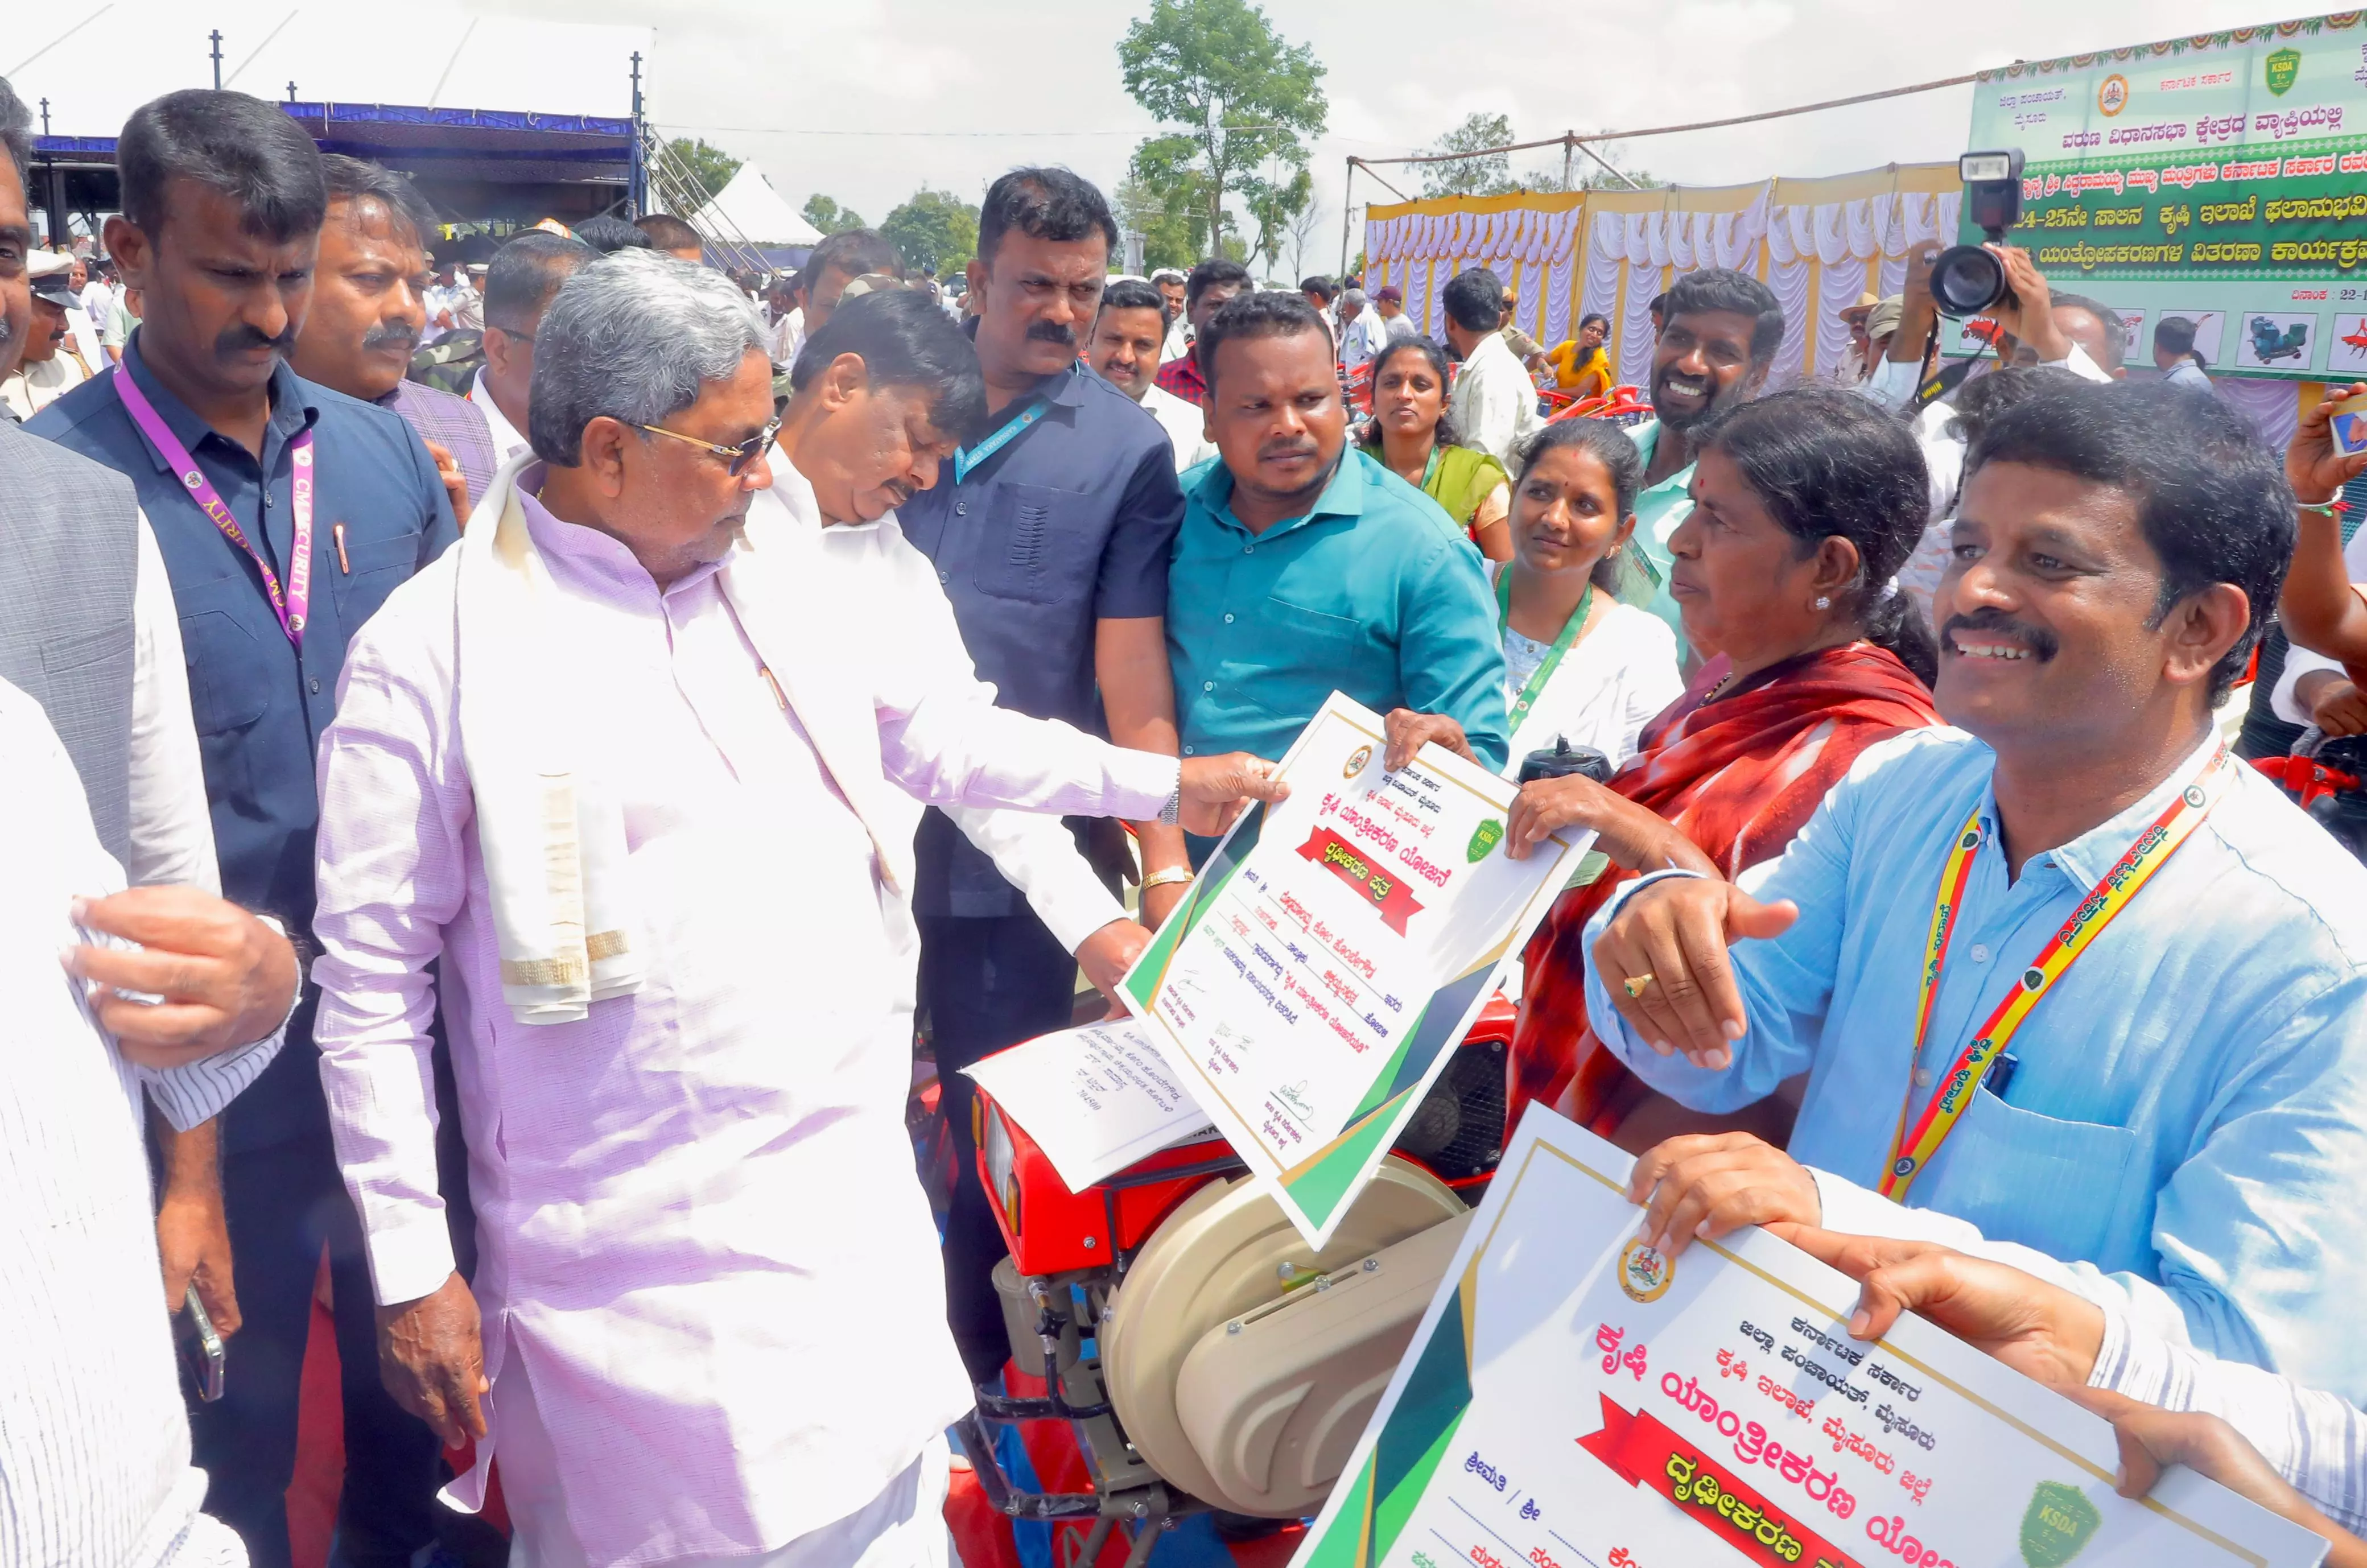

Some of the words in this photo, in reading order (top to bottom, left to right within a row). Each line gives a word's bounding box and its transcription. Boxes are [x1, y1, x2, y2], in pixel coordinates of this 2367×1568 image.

[2160, 75, 2197, 90] ಕರ್ನಾಟಕ
[2201, 71, 2232, 85] ಸರ್ಕಾರ
[2271, 62, 2292, 72] KSDA
[1999, 96, 2017, 109] ಜಿಲ್ಲಾ
[2014, 112, 2047, 130] ಮೈಸೂರು
[2062, 130, 2101, 148] ವರುಣ
[2109, 122, 2187, 146] ವಿಧಾನಸಭಾ
[2196, 112, 2246, 145] ಕ್ಷೇತ್ರದ
[2255, 105, 2343, 139] ವ್ಯಾಪ್ತಿಯಲ್ಲಿ
[2045, 174, 2061, 195] ಶ್ರೀ
[2128, 170, 2156, 192] ಮುಖ್ಯ
[2222, 160, 2279, 179] ಕರ್ನಾಟಕ
[2284, 156, 2334, 176] ಸರ್ಕಾರ
[2094, 205, 2144, 226] ಸಾಲಿನ
[2159, 204, 2191, 234] ಕೃಷಿ
[2200, 195, 2257, 224] ಇಲಾಖೆ
[2039, 241, 2184, 271] ಯಂತ್ರೋಪಕರಣಗಳ
[2191, 242, 2262, 262] ವಿತರಣಾ
[2291, 288, 2328, 301] ದಿನಾಂಕ
[295, 478, 311, 507] CM
[291, 511, 311, 603] SECURITY
[1319, 792, 1342, 816] ಕೃಷಿ
[1339, 805, 1399, 853] ಯಾಂತ್ರೀಕರಣ
[1399, 845, 1453, 888] ಯೋಜನೆ
[1478, 829, 1494, 845] KSDA
[2107, 825, 2169, 892] ಕರ್ನಾಟಕ
[1323, 841, 1370, 881] ದೃಢೀಕರಣ
[1368, 874, 1393, 901] ಪತ್ರ
[1933, 903, 1952, 951] ಇಲಾಖೆ
[2059, 890, 2109, 947] ಸರ್ಕಾರ
[1383, 994, 1402, 1013] ಇವರು
[1965, 1037, 1993, 1063] ಕೃಷಿ
[1939, 1068, 1972, 1114] ಇಲಾಖೆ
[1790, 1316, 1865, 1367] ಕರ್ನಾಟಕ
[1867, 1363, 1923, 1403] ಸರ್ಕಾರ
[1739, 1319, 1775, 1355] ಜಿಲ್ಲಾ
[1874, 1402, 1936, 1451] ಮೈಸೂರು
[1595, 1322, 1648, 1383] ಕೃಷಿ
[1660, 1371, 1857, 1520] ಯಾಂತ್ರೀಕರಣ
[1866, 1515, 1961, 1568] ಯೋ
[1716, 1347, 1749, 1383] ಕೃಷಿ
[1757, 1375, 1817, 1424] ಇಲಾಖೆ,
[1822, 1416, 1895, 1476] ಮೈಸೂರು
[1899, 1470, 1933, 1507] ಜಿಲ್ಲೆ
[1464, 1451, 1507, 1492] ಶ್ರೀಮತಿ
[1520, 1497, 1540, 1521] ಶ್ರೀ
[1665, 1451, 1804, 1562] ದೃಢೀಕರಣ
[2038, 1504, 2078, 1538] KSDA
